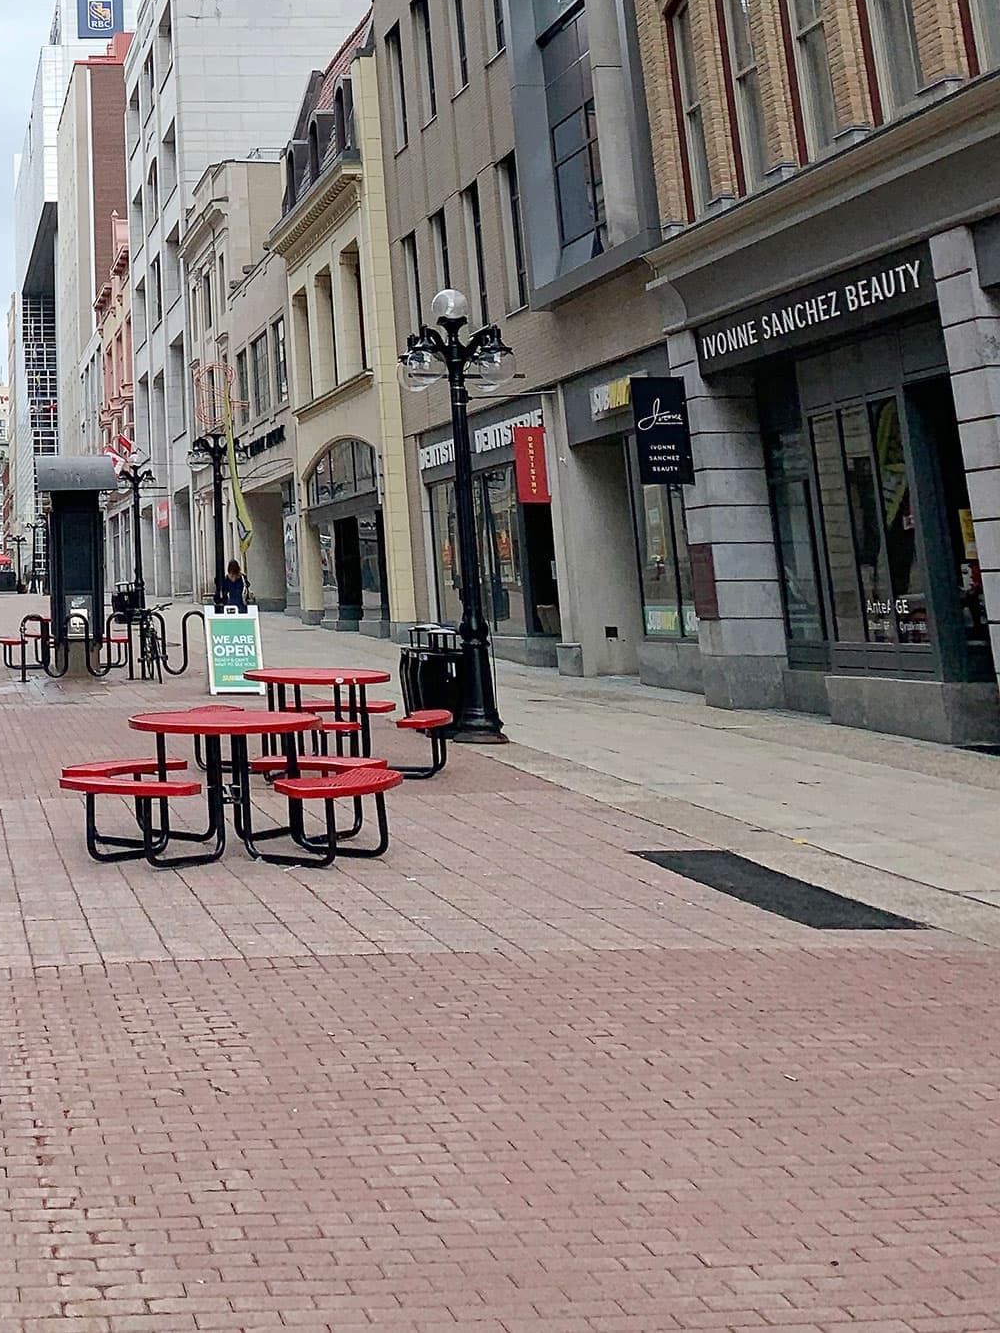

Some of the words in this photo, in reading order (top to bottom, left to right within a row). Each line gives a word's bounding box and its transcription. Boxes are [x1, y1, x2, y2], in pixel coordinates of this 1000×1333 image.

[91, 20, 110, 28] RBC
[702, 321, 758, 360] IVONNE
[761, 291, 841, 340] SANCHEZ
[845, 260, 920, 312] BEAUTY
[419, 438, 455, 470] DENTIST
[527, 435, 537, 495] DENTISTRY
[212, 635, 230, 644] WE
[232, 635, 254, 644] ARE
[213, 645, 256, 657] OPEN
